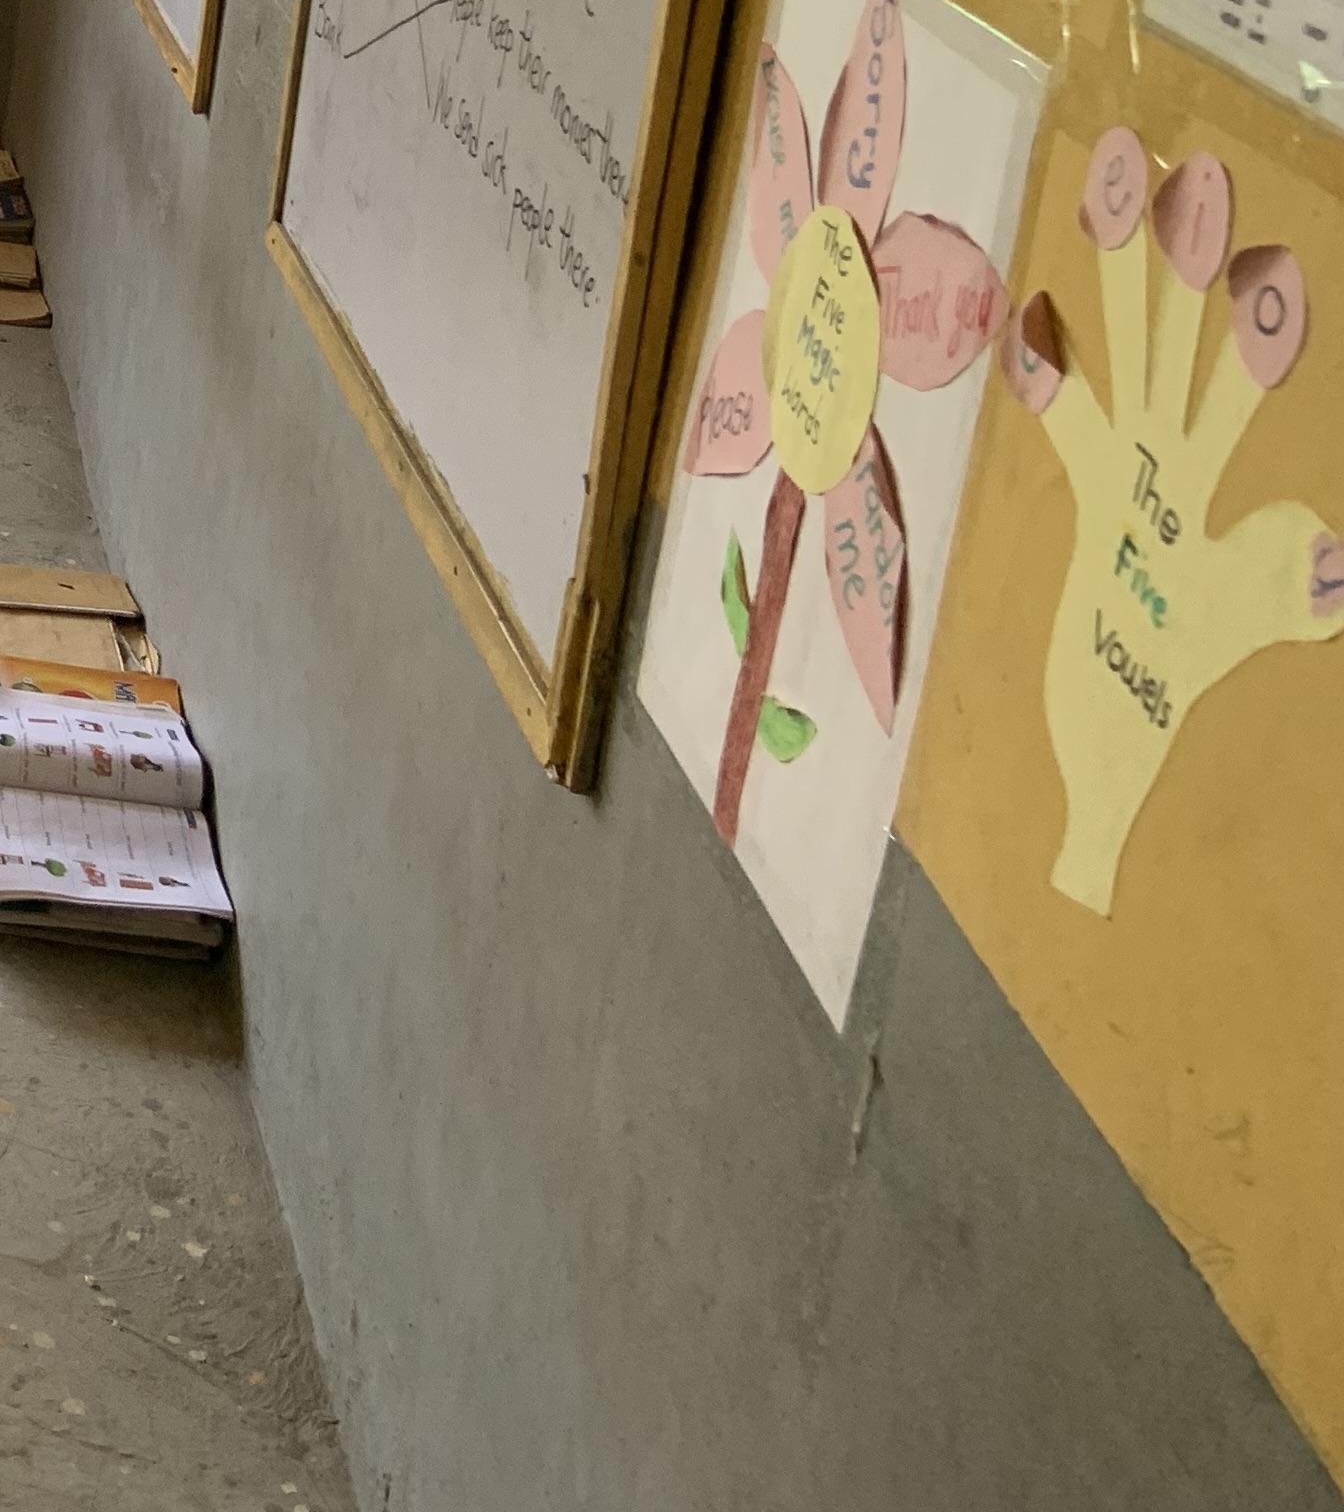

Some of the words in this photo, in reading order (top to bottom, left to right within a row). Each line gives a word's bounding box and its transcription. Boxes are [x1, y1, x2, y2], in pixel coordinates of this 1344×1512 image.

[518, 10, 552, 95] their
[454, 97, 485, 158] send
[505, 182, 554, 283] people
[821, 219, 853, 277] The
[813, 275, 845, 335] Five
[797, 315, 841, 392] Magic
[1134, 442, 1181, 546] The
[833, 518, 871, 613] me
[1113, 534, 1168, 629] Five
[1093, 609, 1172, 729] Vowels
